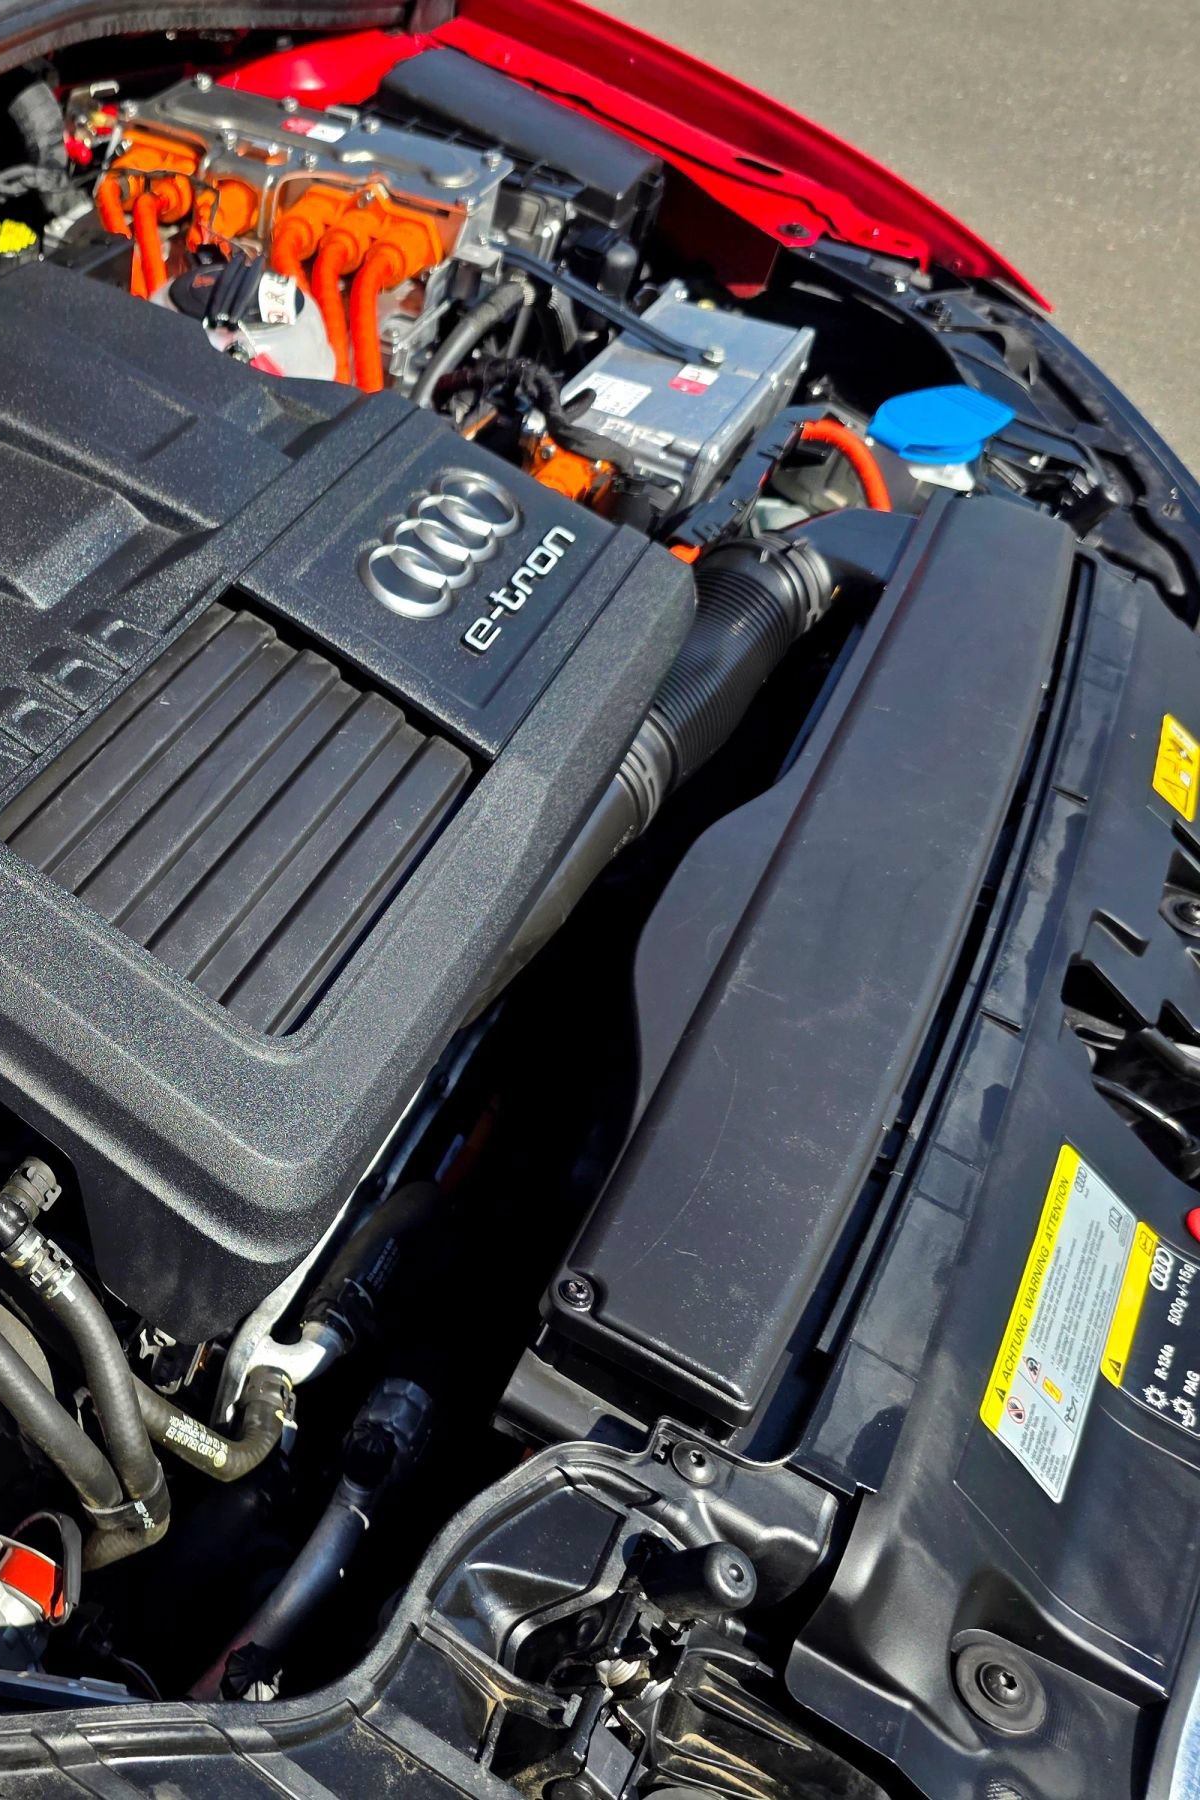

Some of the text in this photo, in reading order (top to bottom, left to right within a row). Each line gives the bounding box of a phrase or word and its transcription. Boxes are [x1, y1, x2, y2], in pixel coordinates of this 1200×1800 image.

[464, 525, 576, 651] e-tron
[1003, 1314, 1029, 1384] ACHTUNG
[1024, 1246, 1050, 1310] WARNING
[1046, 1177, 1070, 1243] ATTENTION
[1167, 1297, 1189, 1326] 500g
[1154, 1344, 1175, 1381] R-134a
[1183, 1370, 1200, 1397] PAG
